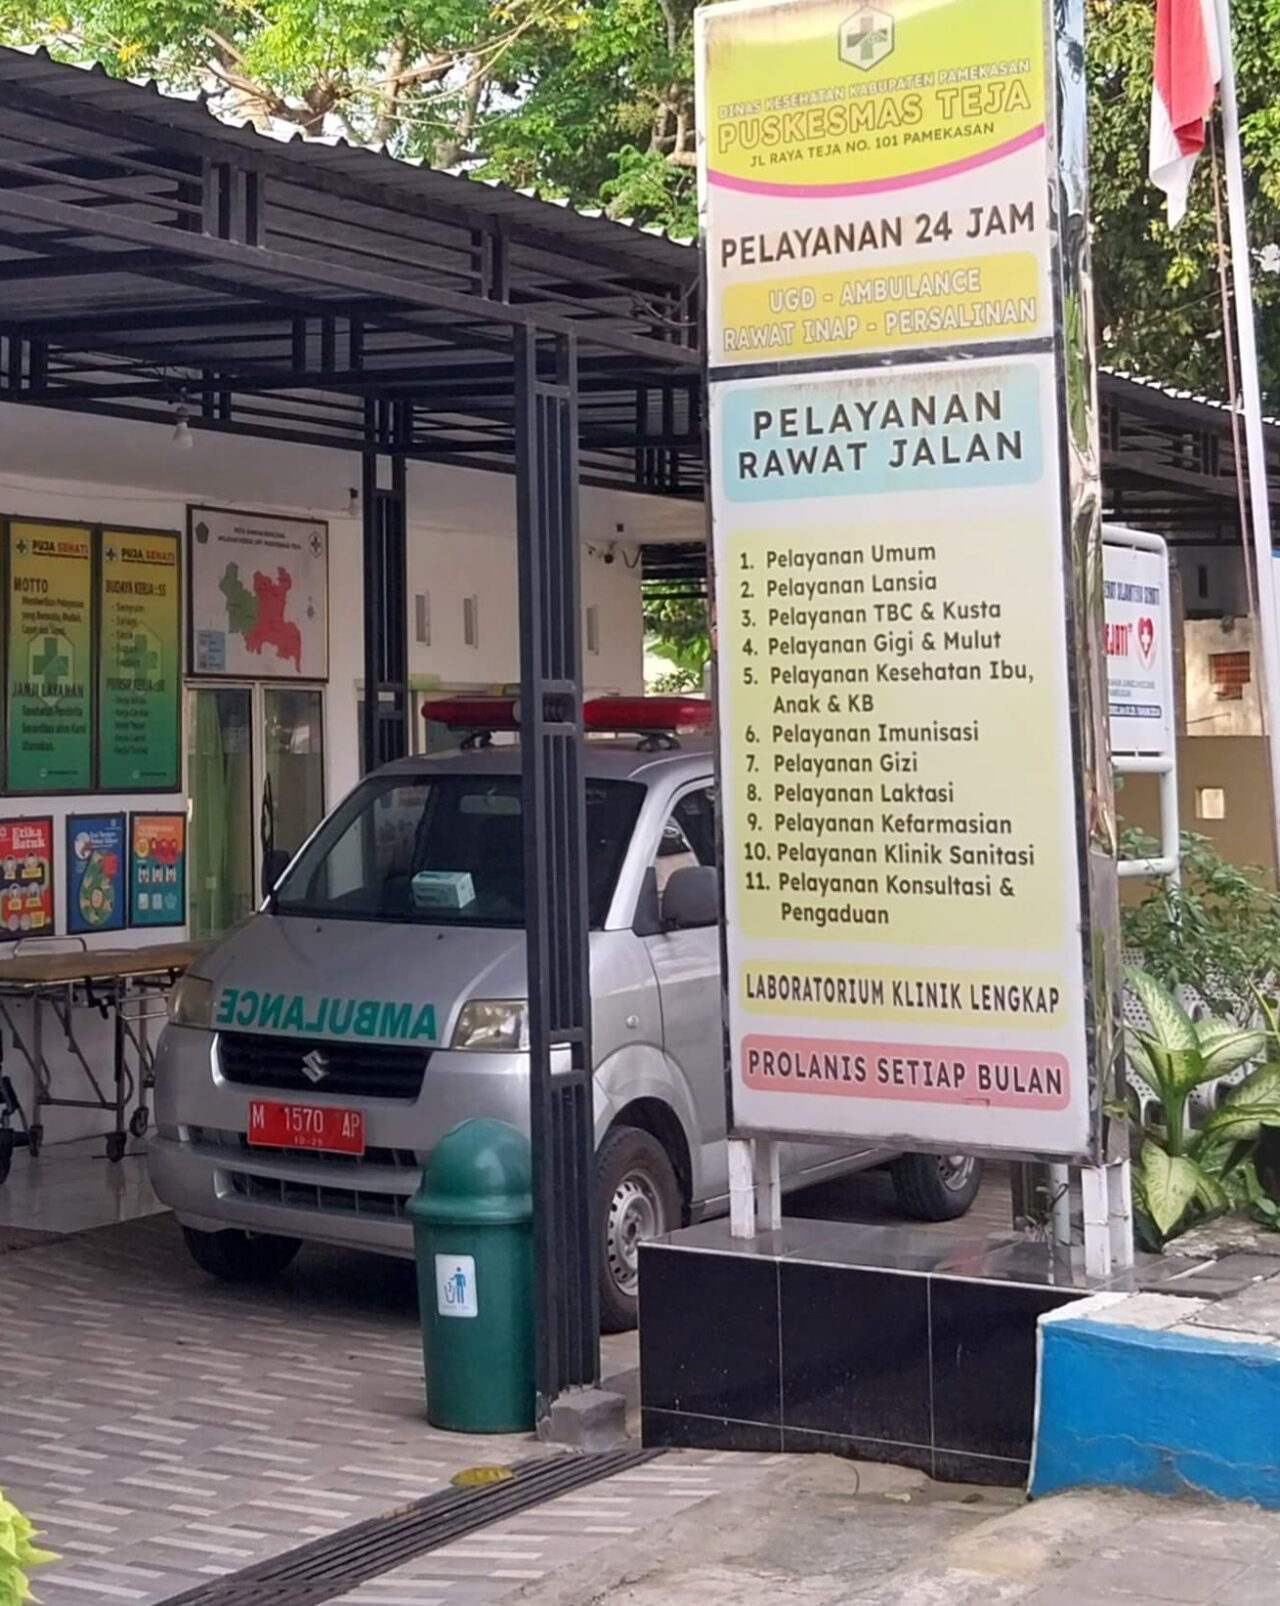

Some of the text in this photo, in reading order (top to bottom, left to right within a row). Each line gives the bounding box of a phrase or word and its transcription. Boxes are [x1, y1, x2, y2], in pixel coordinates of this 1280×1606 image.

[719, 59, 1031, 120] DINAS KESEHATAN KABUPATEN PAMEKASAN
[718, 79, 1031, 154] PUSKESMAS TEJA
[750, 122, 995, 167] JL RAYA TEJA NO. 101 PAMEKASAN
[721, 201, 1035, 268] PELAYANAN 24 JAM
[769, 286, 815, 313] UGD
[840, 268, 981, 306] AMBULANCE
[723, 322, 793, 351] RAWAT
[803, 317, 858, 343] INAP
[885, 297, 1037, 335] PERSALINAN
[753, 390, 1002, 440] PELAYANAN
[738, 430, 1022, 480] RAWAT JALAN
[33, 540, 55, 551] PUJA
[122, 548, 143, 558] PUJA
[740, 544, 936, 571] 1. Pelayanan Umum
[14, 577, 48, 593] MOTTO
[740, 570, 937, 600] 2. Pelayanan Lansia
[741, 600, 1002, 629] 3. Pelayanan TBC & Kusta
[742, 630, 1002, 659] 4. Pelayanan Gigi & Mulut
[743, 660, 1034, 688] 5. Pelayanan Kesehatan Ibu,
[41, 683, 83, 698] LAYANAN
[773, 694, 875, 714] Anak & KB
[745, 720, 980, 748] 6. Pelayanan Imunisasi
[746, 751, 919, 778] 7. Pelayanan Gizi
[746, 781, 954, 807] 8. Pelayanan Laktasi
[12, 826, 42, 838] Etika
[747, 812, 1013, 837] 9. Pelayanan Kefarmasian
[12, 837, 45, 850] Batuk
[744, 842, 1035, 867] 10. Pelayanan Klinik Sanitasi
[745, 871, 1015, 897] 11. Pelayanan Konsultasi &
[781, 902, 889, 927] Pengaduan
[745, 973, 1060, 1014] LABORATORIUM KLINIK LENGKAP
[748, 1050, 1062, 1095] PROLANIS SETIAP BULAN
[252, 1104, 360, 1138] M 1570 AP
